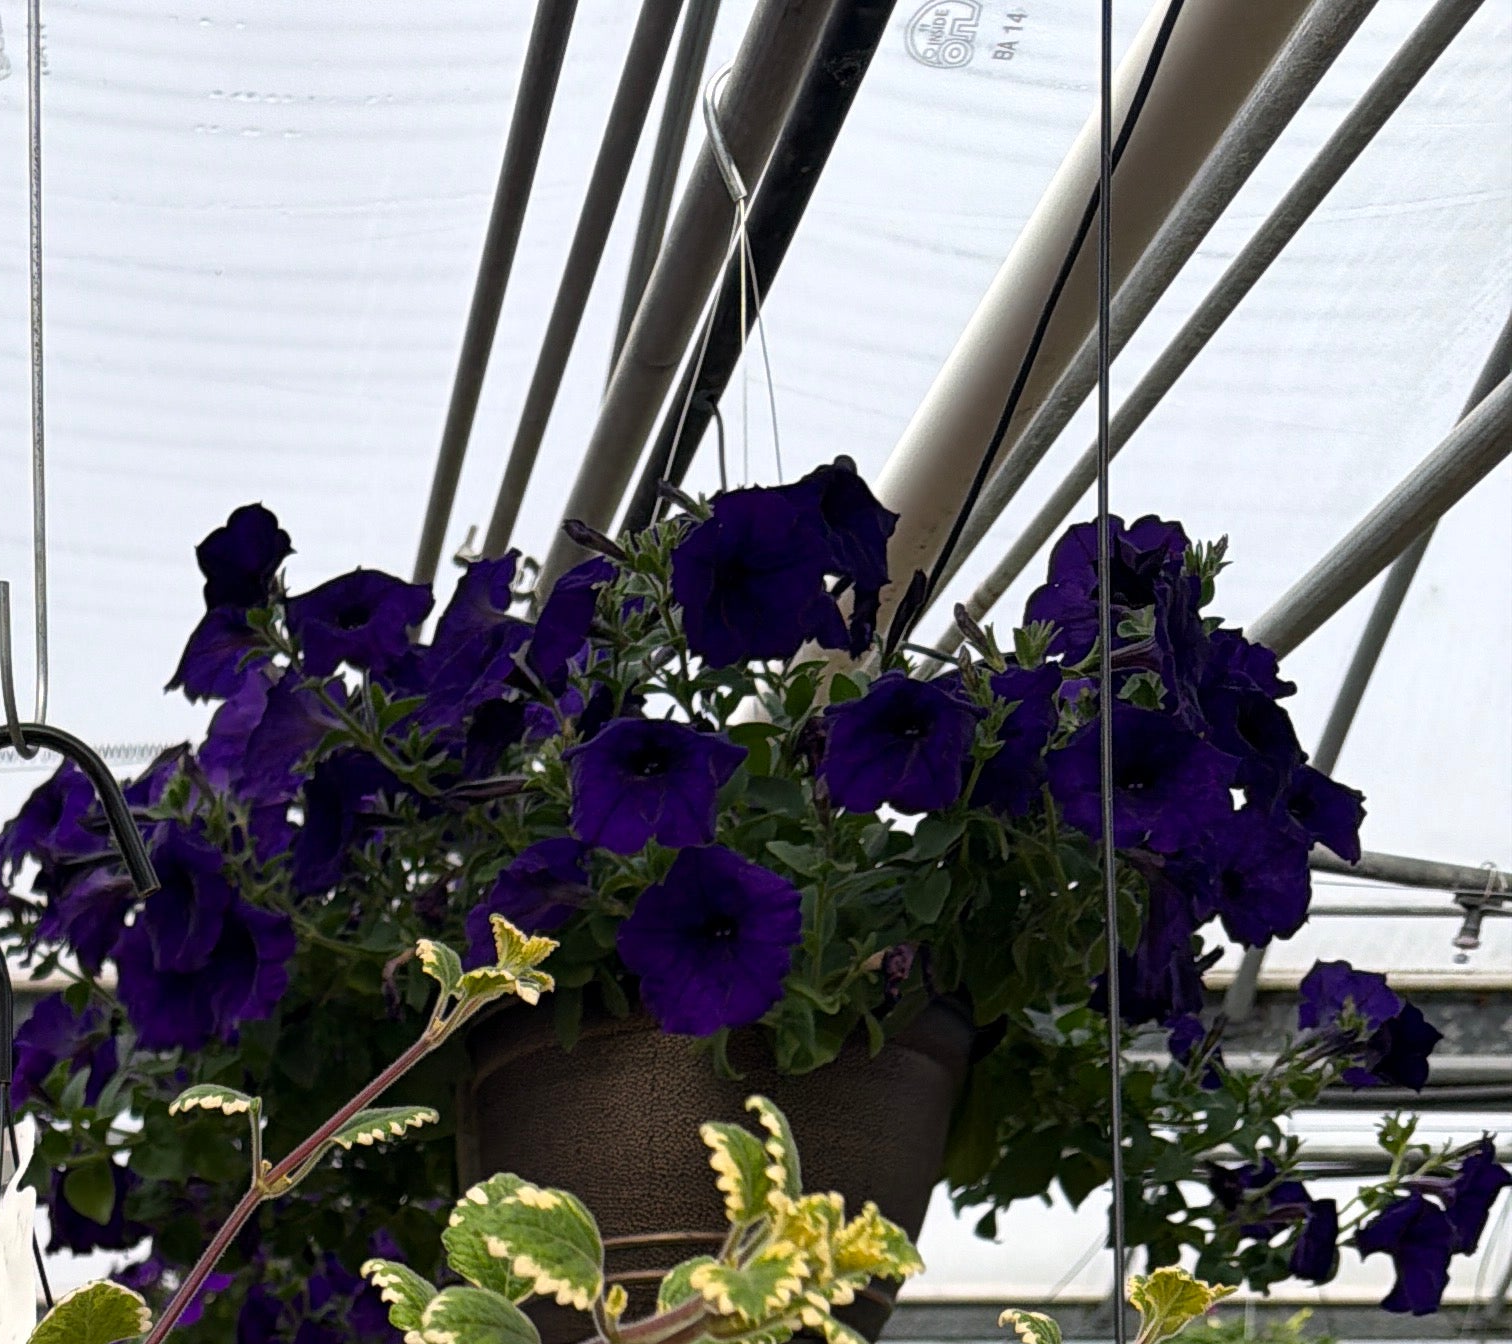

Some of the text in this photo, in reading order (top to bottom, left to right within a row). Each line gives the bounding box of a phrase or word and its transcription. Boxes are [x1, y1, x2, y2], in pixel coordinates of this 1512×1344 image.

[926, 9, 950, 46] INSIDE
[991, 13, 1028, 61] BA 14
